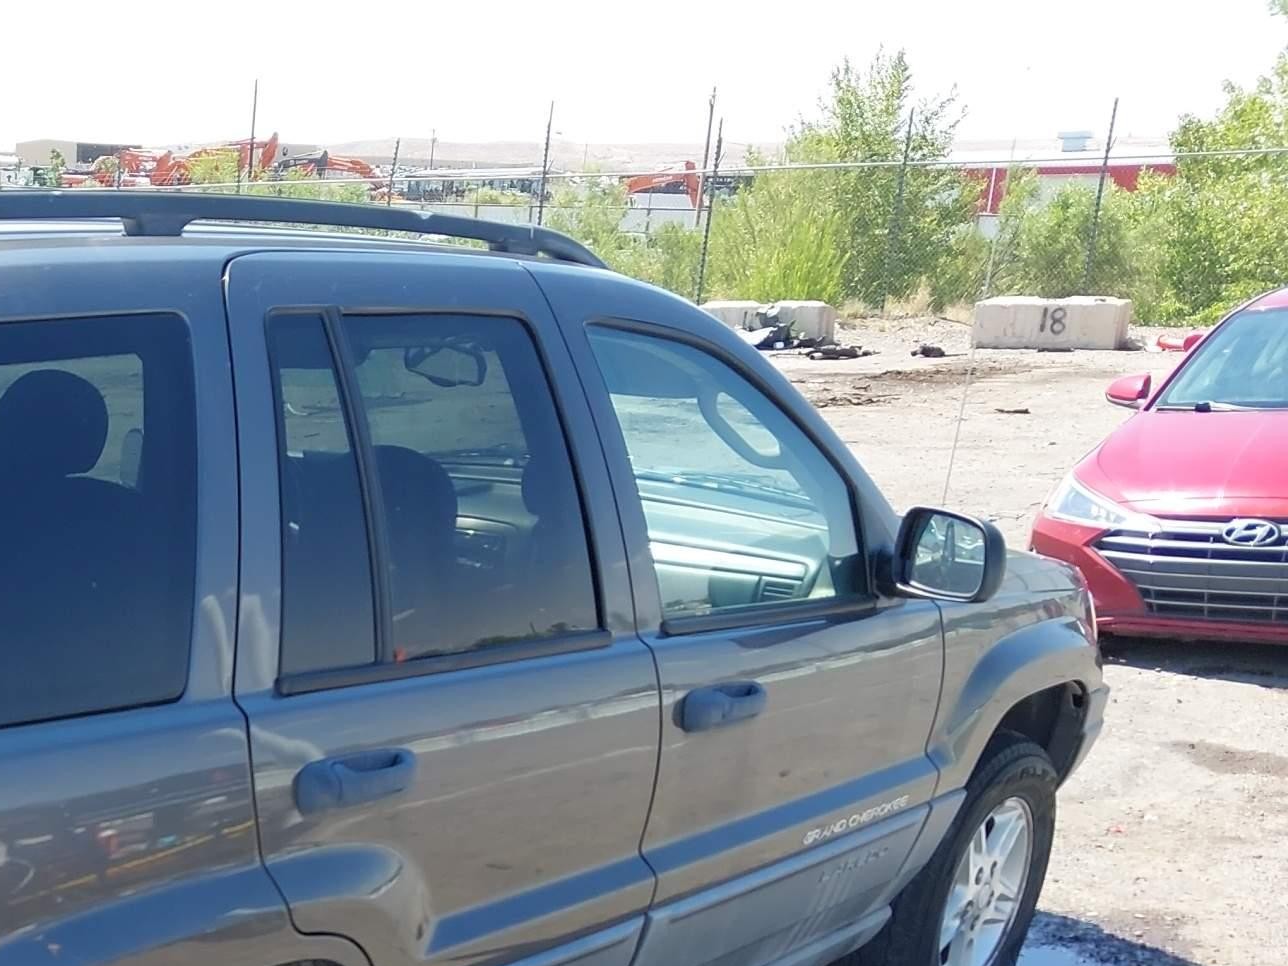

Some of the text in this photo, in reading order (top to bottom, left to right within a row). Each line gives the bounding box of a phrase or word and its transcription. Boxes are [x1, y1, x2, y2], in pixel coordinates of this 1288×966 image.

[1039, 307, 1067, 336] 18
[803, 794, 910, 845] GRAND CHEROKEE
